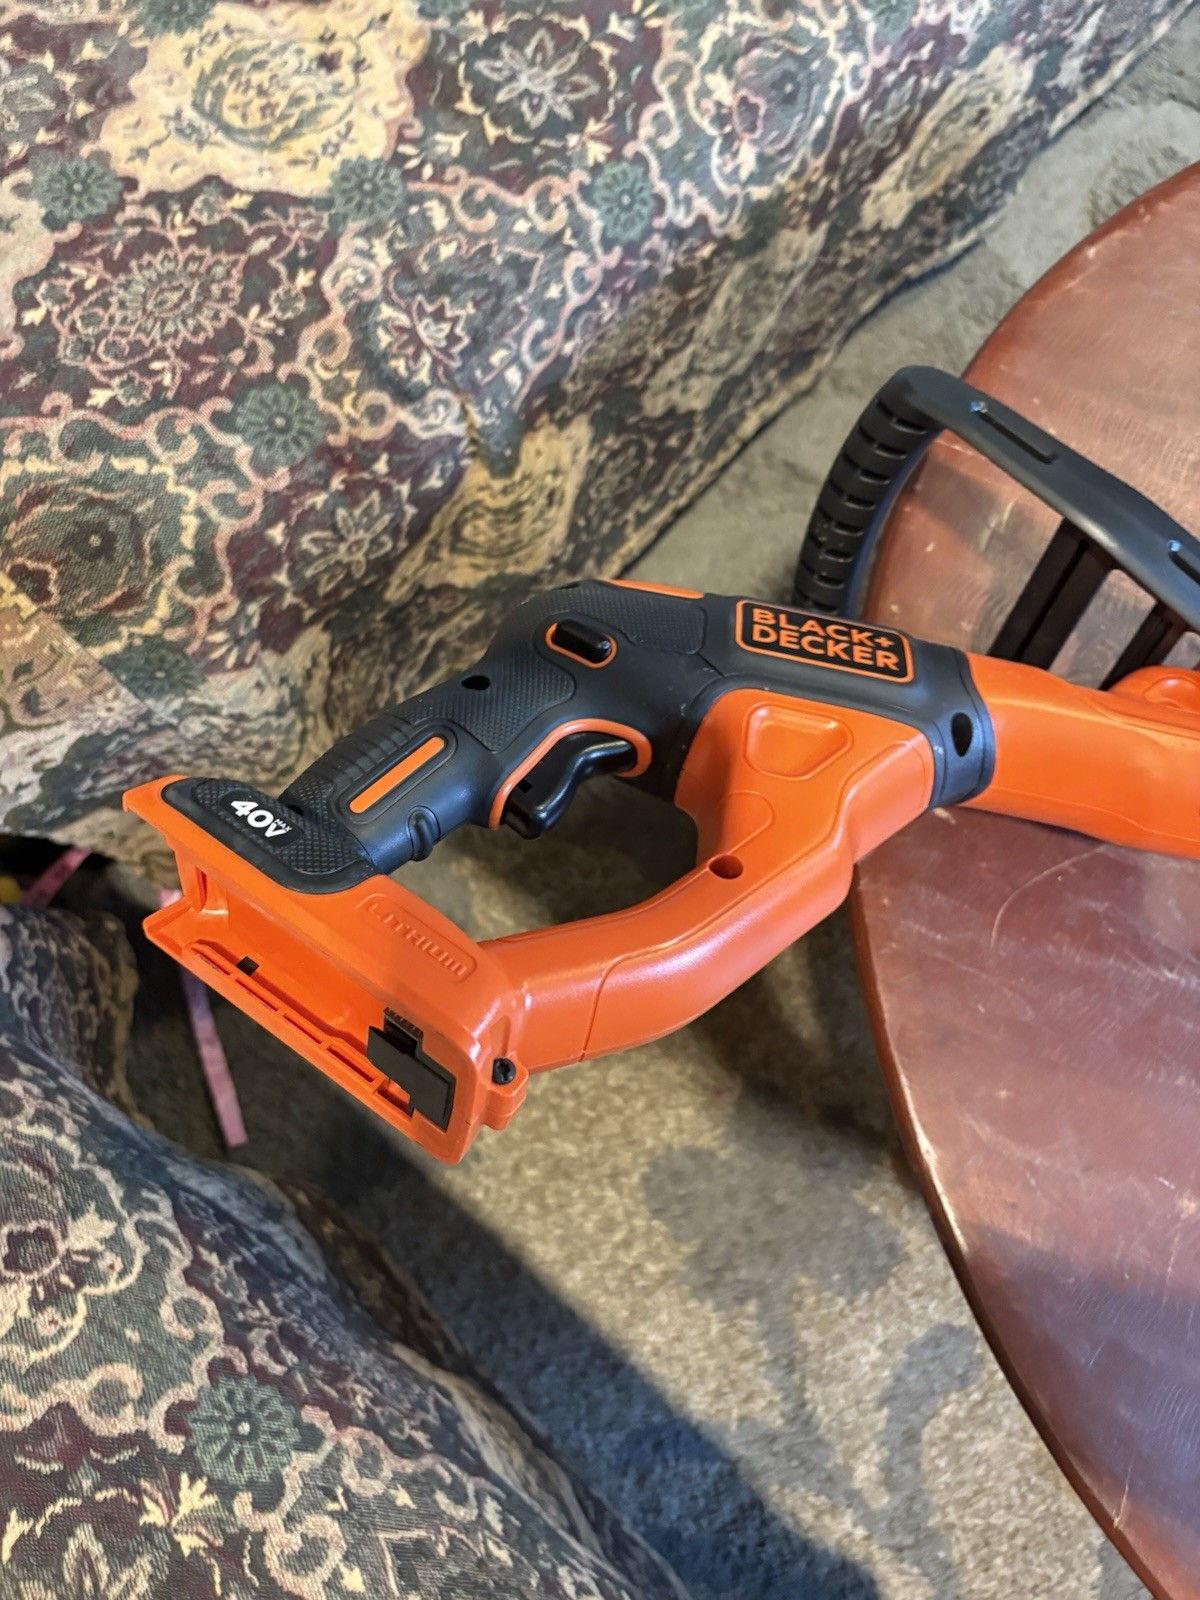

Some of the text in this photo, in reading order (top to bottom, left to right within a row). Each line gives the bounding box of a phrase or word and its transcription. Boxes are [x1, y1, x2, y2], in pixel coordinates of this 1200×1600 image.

[752, 608, 895, 648] BLACK+
[752, 624, 900, 671] DECKER
[230, 800, 288, 838] 40V
[367, 902, 468, 977] LITHIUM
